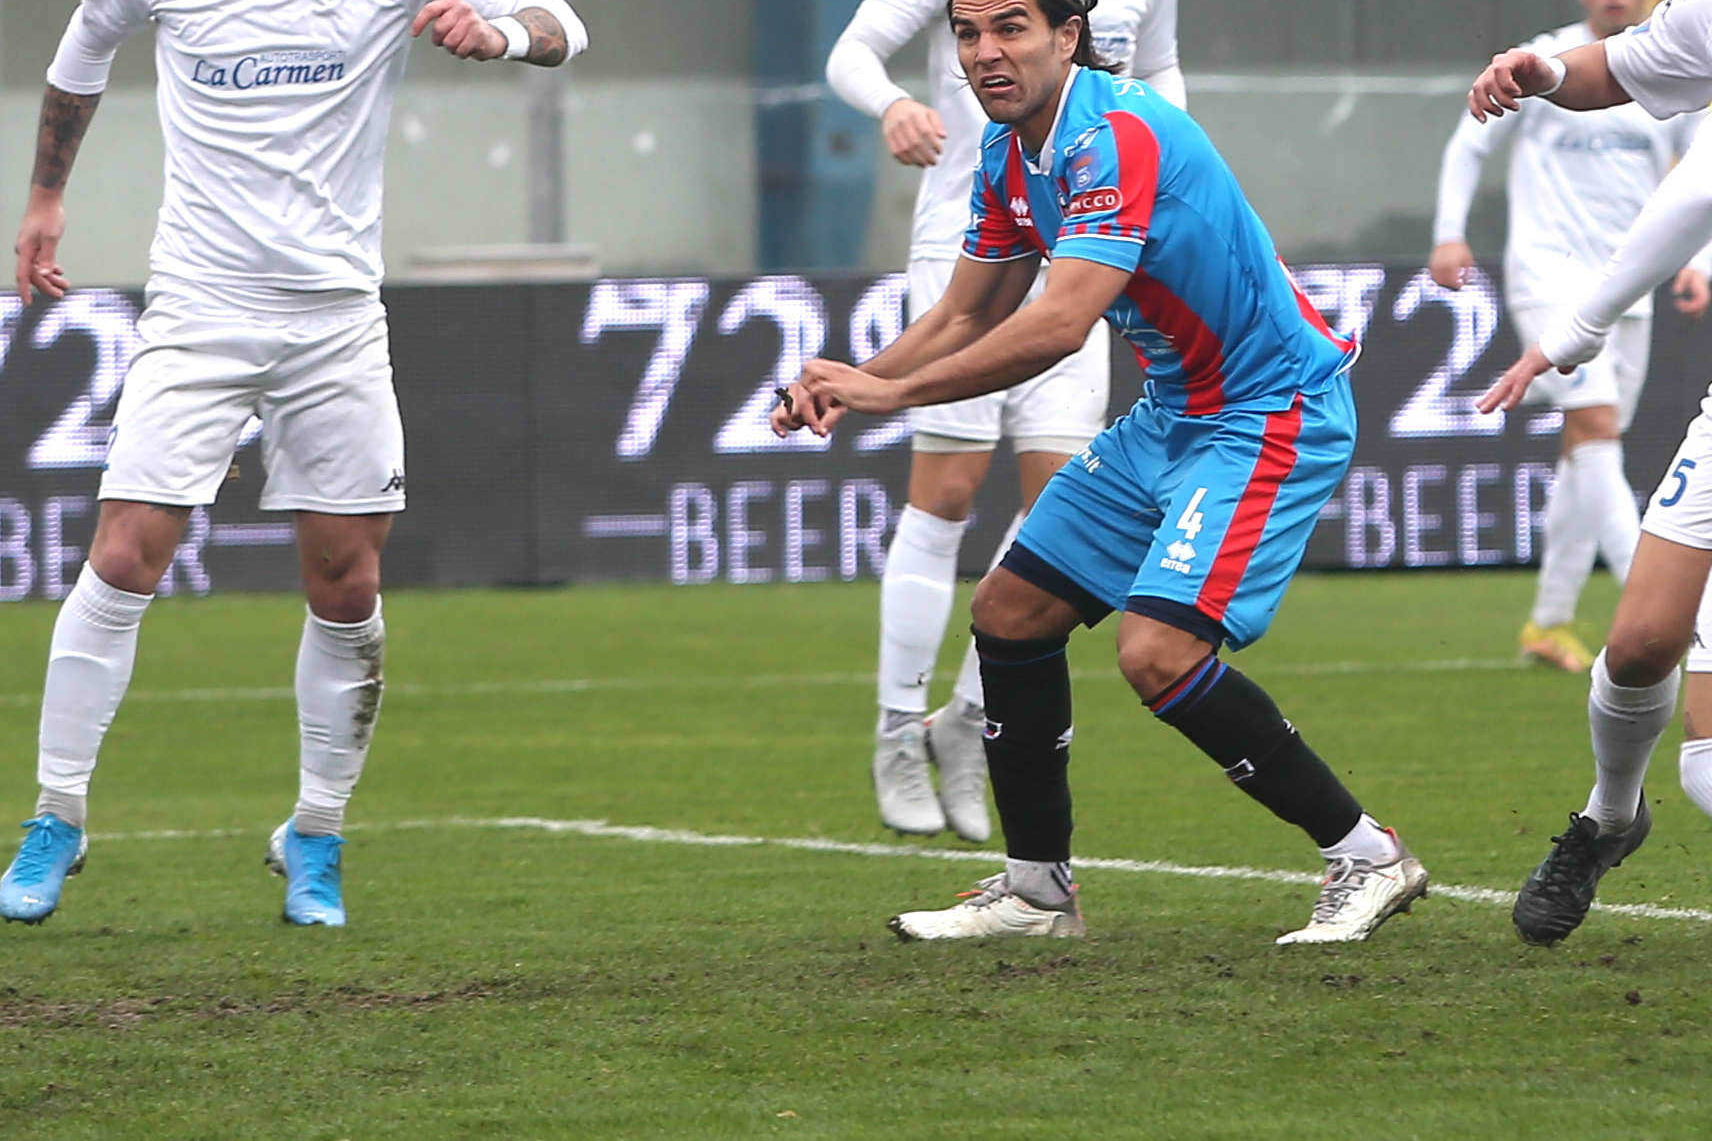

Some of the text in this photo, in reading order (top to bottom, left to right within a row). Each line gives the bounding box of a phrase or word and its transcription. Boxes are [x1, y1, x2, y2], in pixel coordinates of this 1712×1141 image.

[191, 57, 345, 90] La Carmen
[1659, 458, 1696, 507] 5
[668, 478, 887, 585] BEER
[1176, 487, 1208, 540] 4
